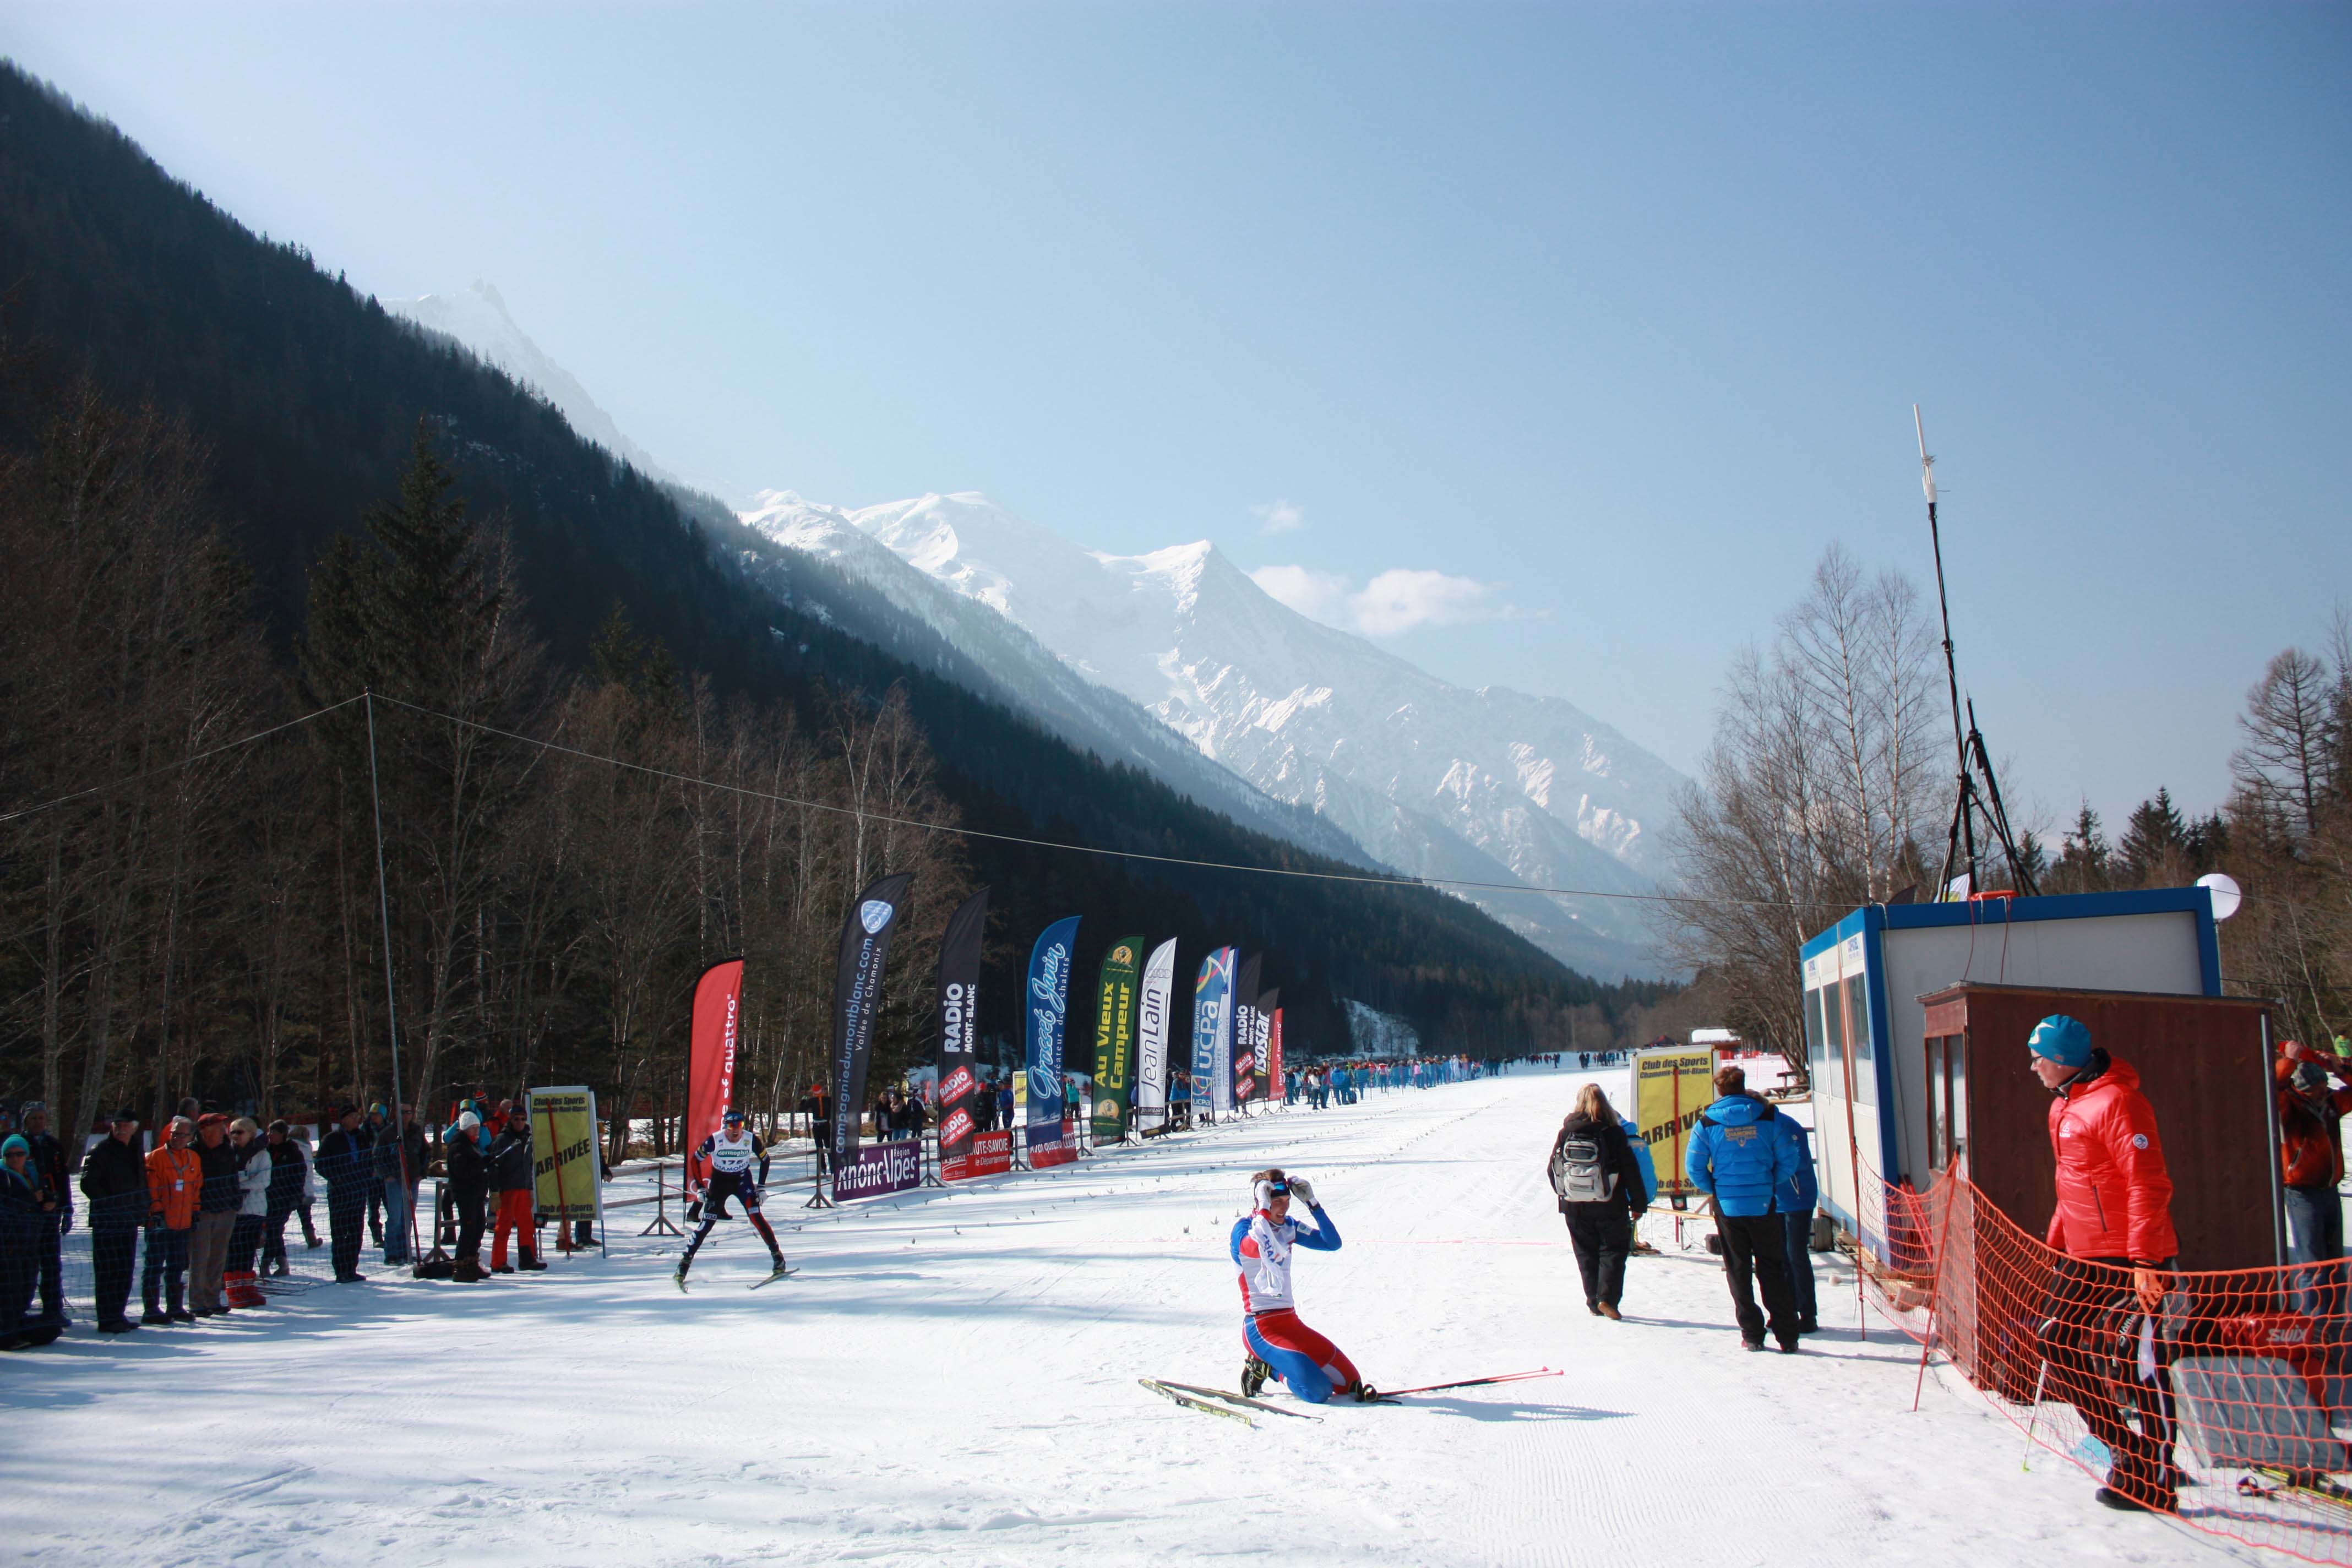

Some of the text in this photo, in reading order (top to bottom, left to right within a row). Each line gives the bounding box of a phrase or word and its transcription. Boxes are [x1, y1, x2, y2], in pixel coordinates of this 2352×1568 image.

[864, 947, 881, 998] Chamonix
[1059, 957, 1070, 998] chalets
[861, 1002, 871, 1015] de
[964, 983, 976, 1053] MONT-BLANC
[1028, 943, 1066, 1099] Grosset Janin
[836, 938, 874, 1154] compagniedumontblanc.com
[854, 1019, 868, 1052] Vallée
[1094, 982, 1114, 1088] Au Vieux
[1110, 982, 1130, 1089] Campeur
[1640, 1068, 1711, 1079] Chamonix-ont-Blanc
[1641, 1057, 1708, 1070] Club des Sports
[721, 1078, 729, 1099] of
[1641, 1104, 1712, 1146] ARRIVÉ
[535, 1137, 591, 1177] ARRIVÉE
[894, 1145, 910, 1158] Région
[967, 1137, 1008, 1156] AUTE-SAVOIE
